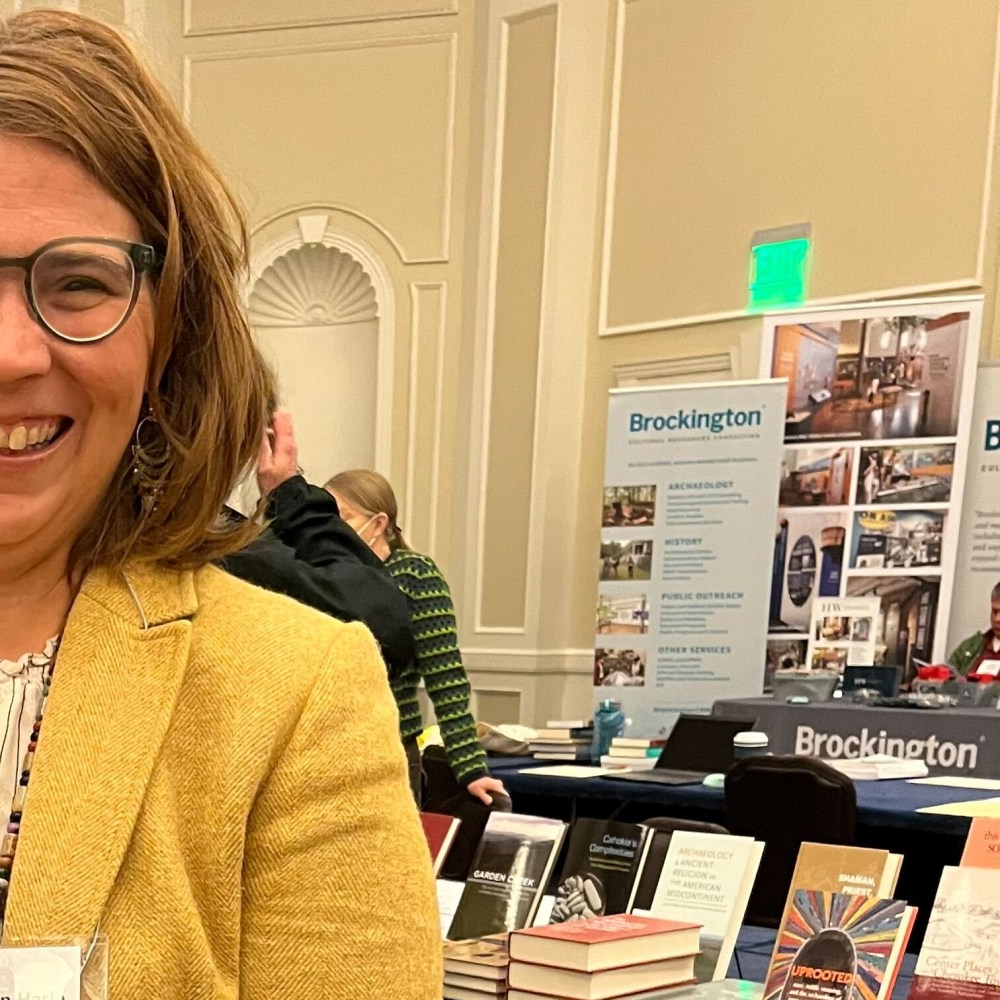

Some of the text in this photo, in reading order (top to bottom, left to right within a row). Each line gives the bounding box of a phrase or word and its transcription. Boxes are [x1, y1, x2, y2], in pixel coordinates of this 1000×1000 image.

[629, 408, 761, 433] Brockington
[668, 481, 734, 490] ARCHAEOLOGY
[665, 538, 704, 546] HISTORY
[661, 592, 744, 600] PUBLIC OUTREACH
[658, 646, 731, 654] OTHER SERVICES
[795, 725, 978, 769] Brockington
[679, 847, 734, 860] ARCHAEOLOGY
[680, 860, 715, 869] ANCIENT
[473, 870, 536, 888] GARDEN CEK
[673, 869, 708, 880] RELIGION
[682, 881, 721, 892] AMERICAN
[667, 890, 726, 903] MIDCONTINENT
[926, 955, 960, 969] Center
[791, 965, 853, 984] UPROOTED
